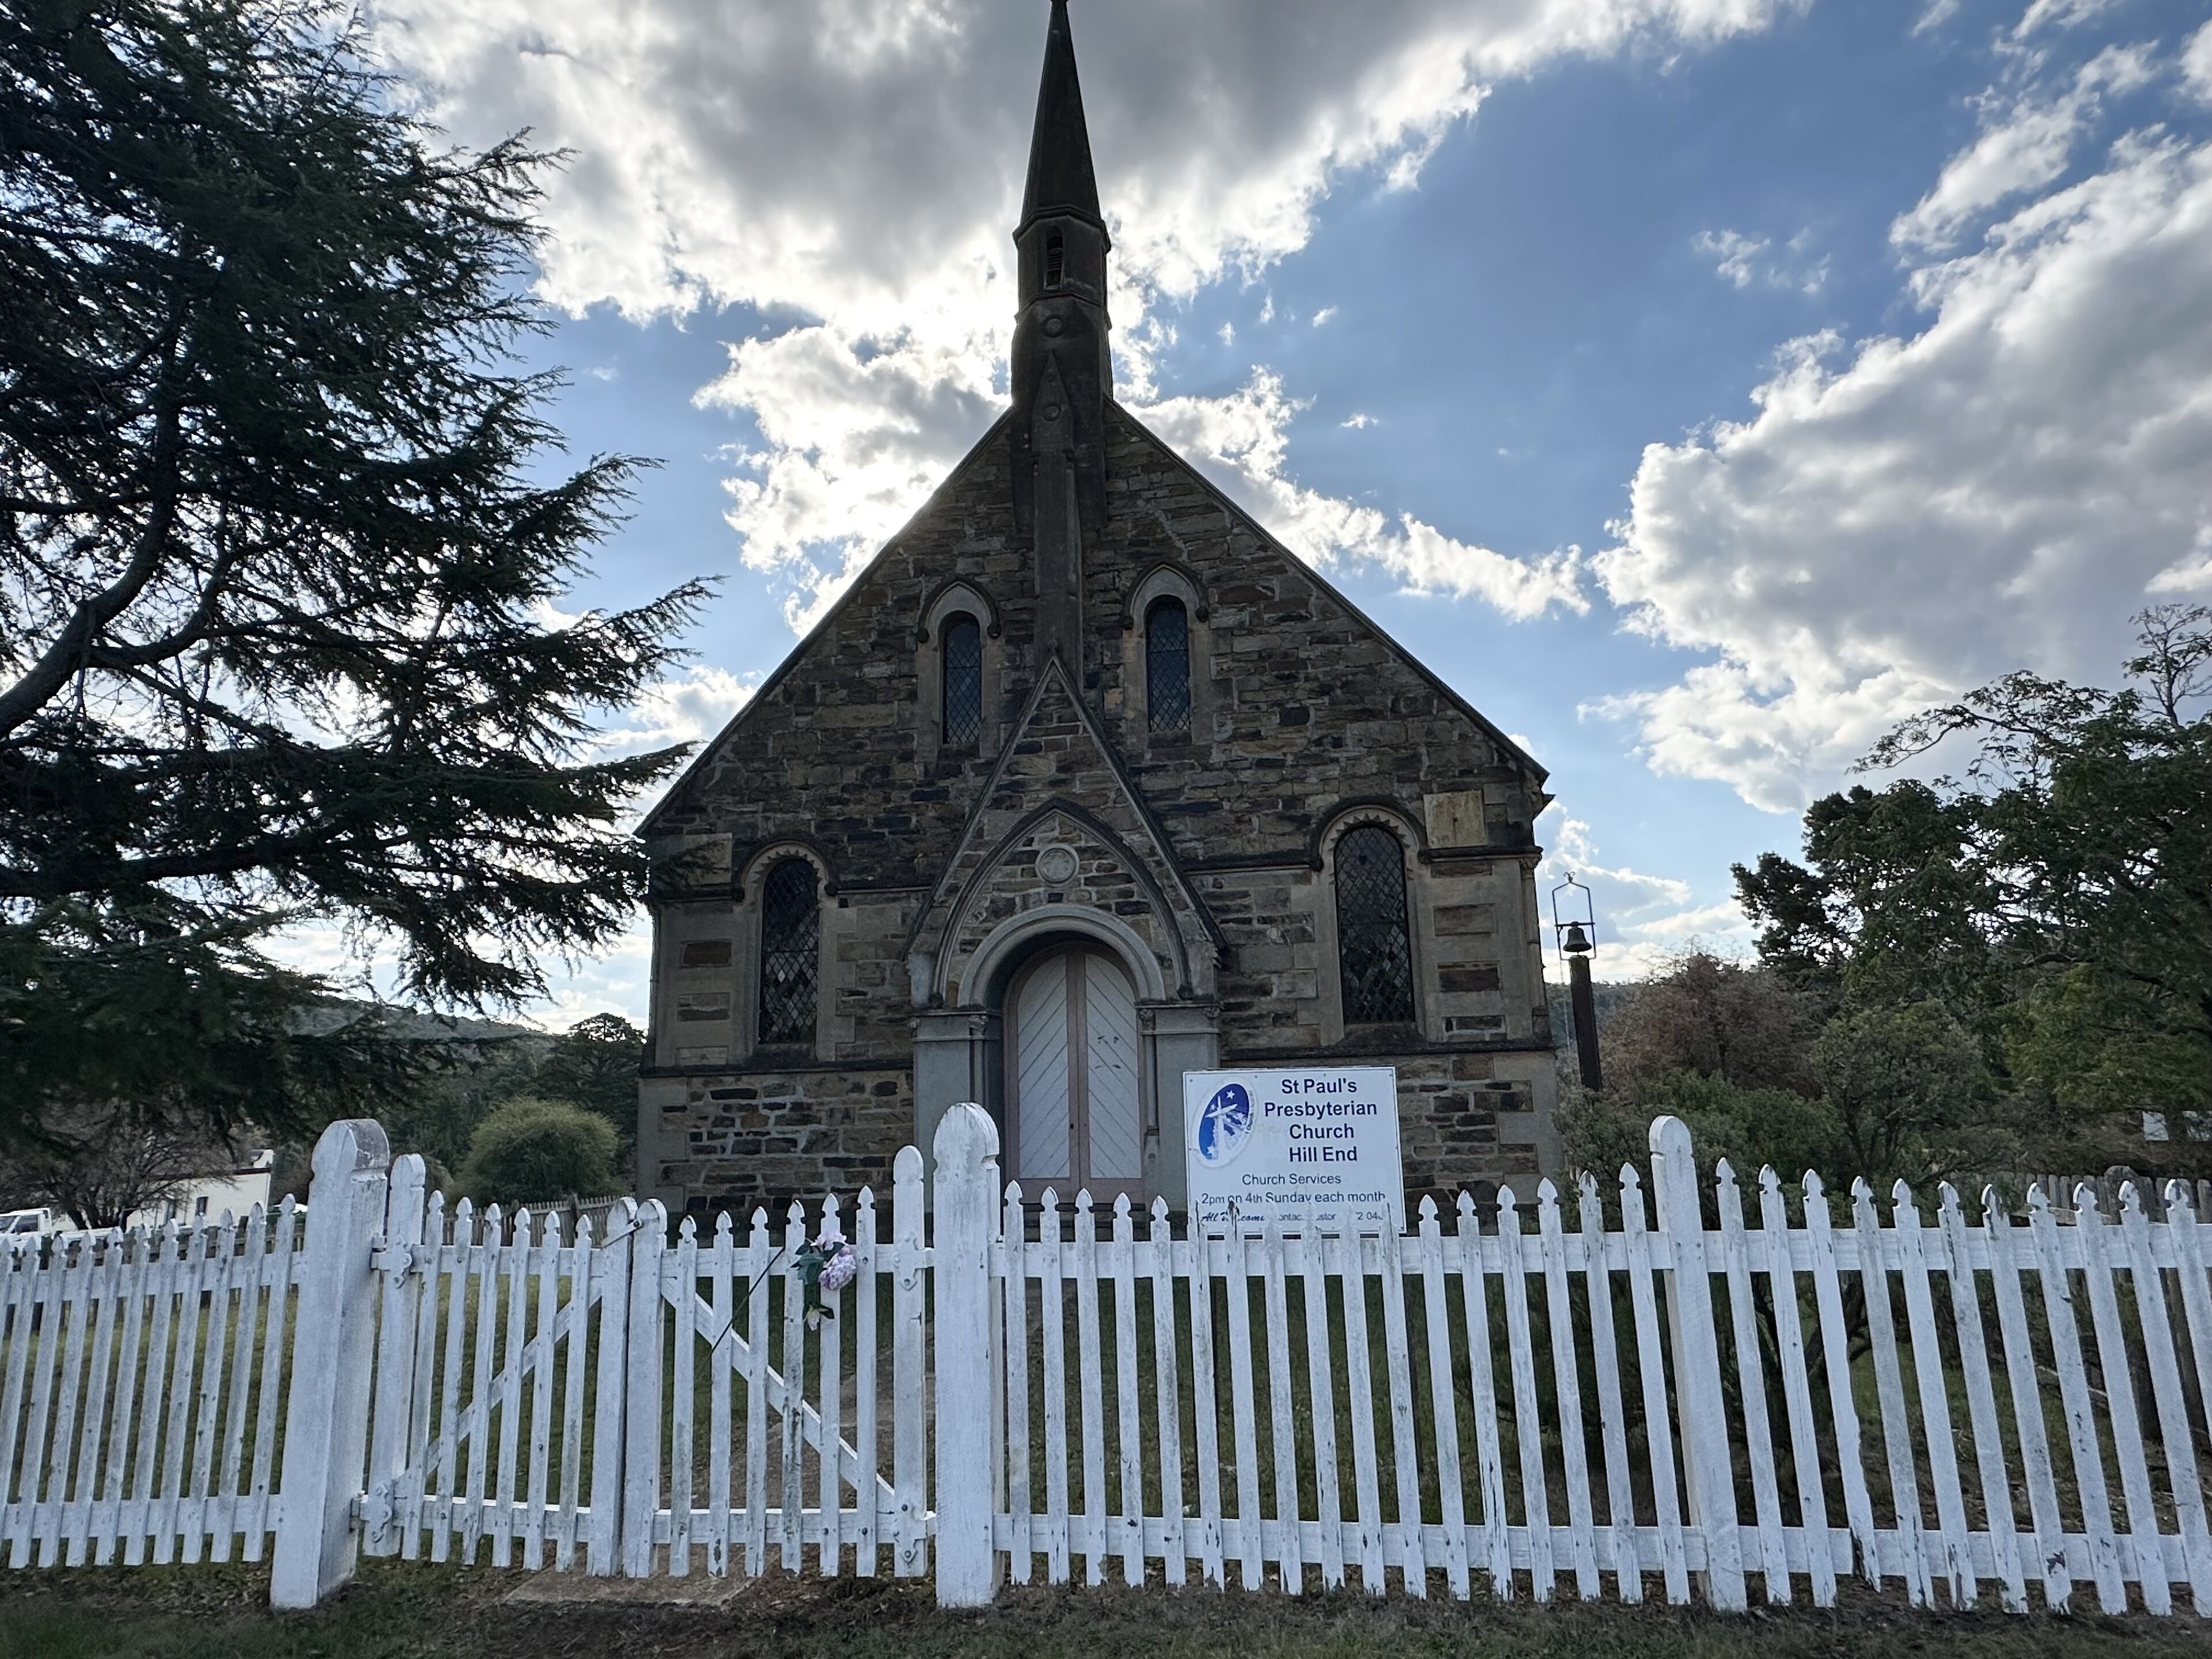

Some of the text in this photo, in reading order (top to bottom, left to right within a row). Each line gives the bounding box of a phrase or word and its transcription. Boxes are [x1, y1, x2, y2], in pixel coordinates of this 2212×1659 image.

[1282, 1078, 1357, 1094] St Paul's
[1264, 1100, 1377, 1120] Presbyterian
[1289, 1123, 1354, 1139] Church
[1289, 1146, 1358, 1162] Hill End
[1242, 1173, 1342, 1185] Church Services
[1201, 1192, 1225, 1206] 2pm
[1245, 1192, 1262, 1203] 4th
[1315, 1191, 1344, 1202] each
